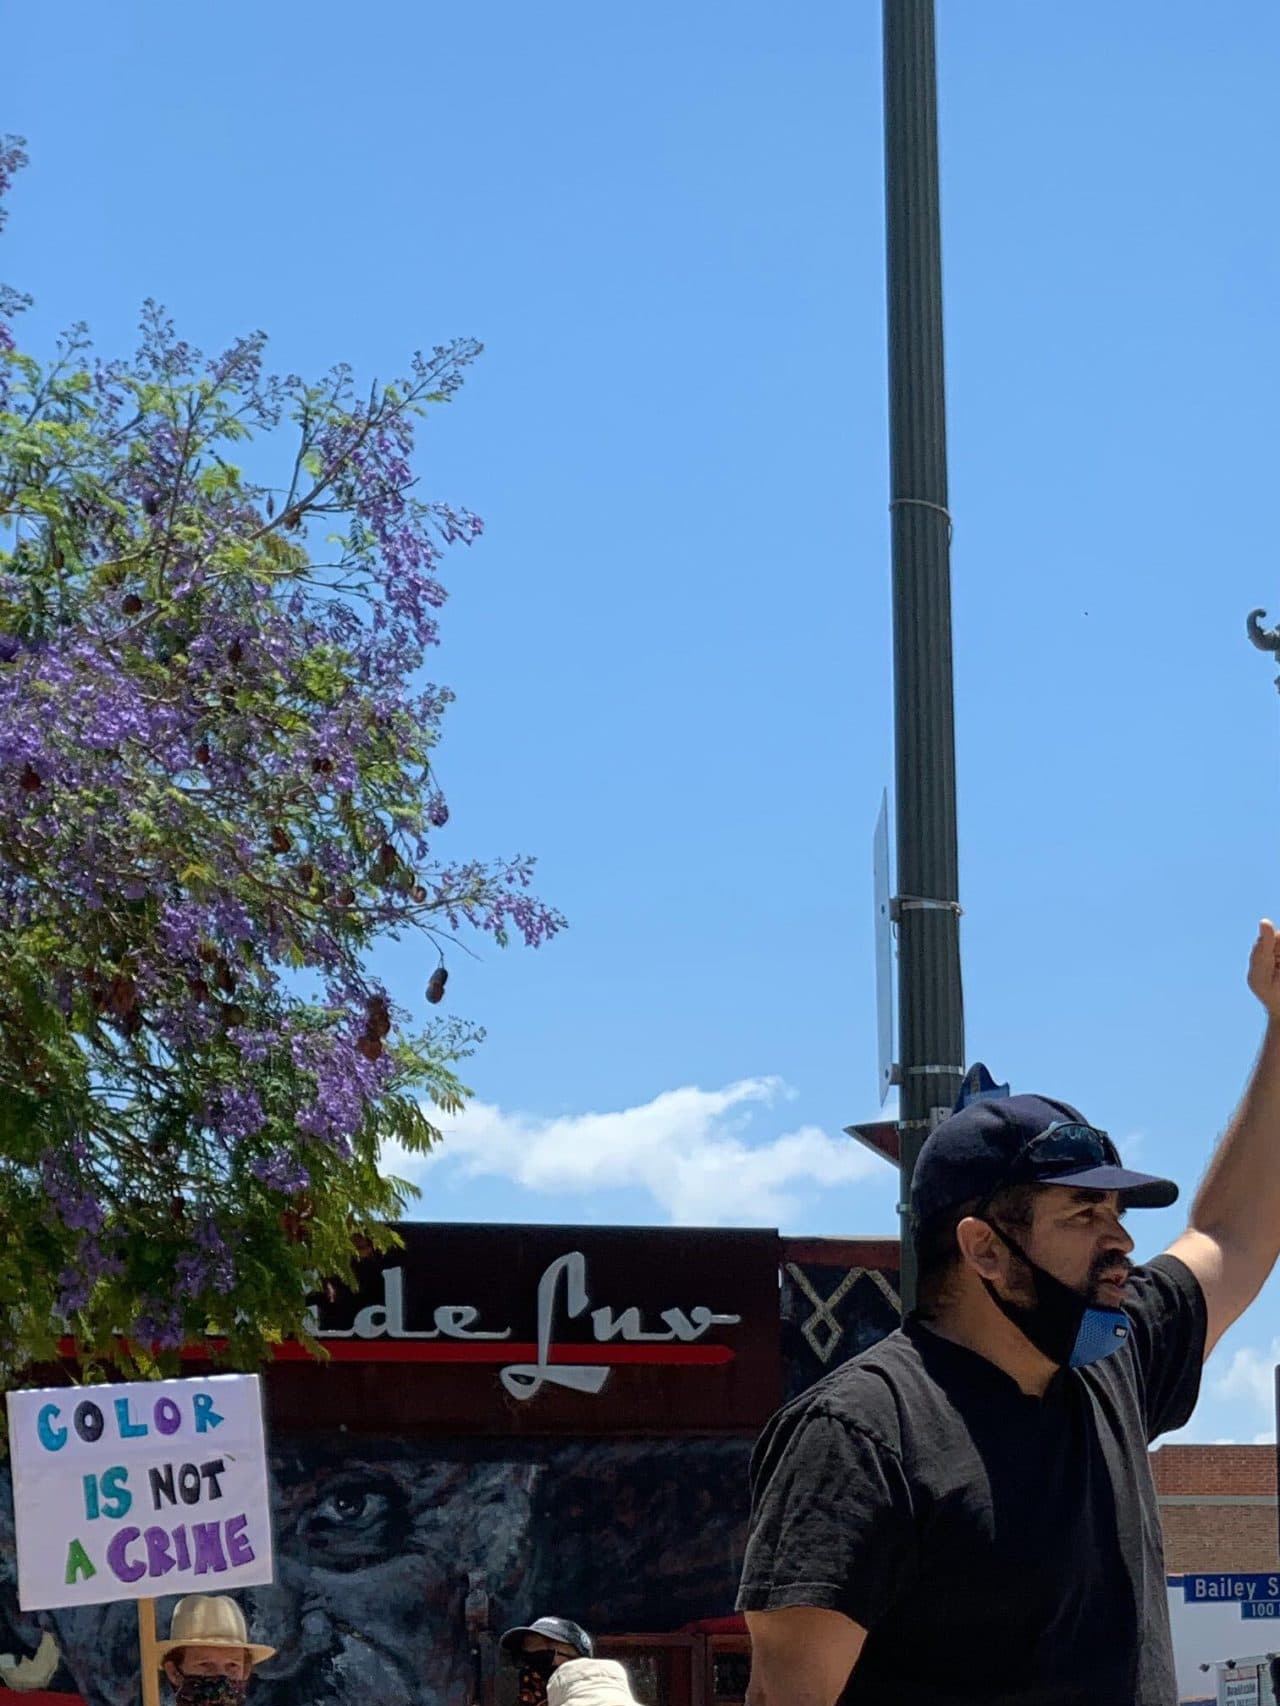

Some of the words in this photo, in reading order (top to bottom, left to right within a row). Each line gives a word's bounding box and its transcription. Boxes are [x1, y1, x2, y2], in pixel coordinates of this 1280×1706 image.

[500, 1251, 741, 1400] Luv
[37, 1393, 225, 1452] COLOR
[82, 1466, 133, 1520] IS
[148, 1458, 226, 1511] NOT
[65, 1538, 97, 1585] A
[106, 1513, 256, 1583] CRIME
[1195, 1578, 1257, 1599] Bailey
[1251, 1603, 1275, 1617] 100
